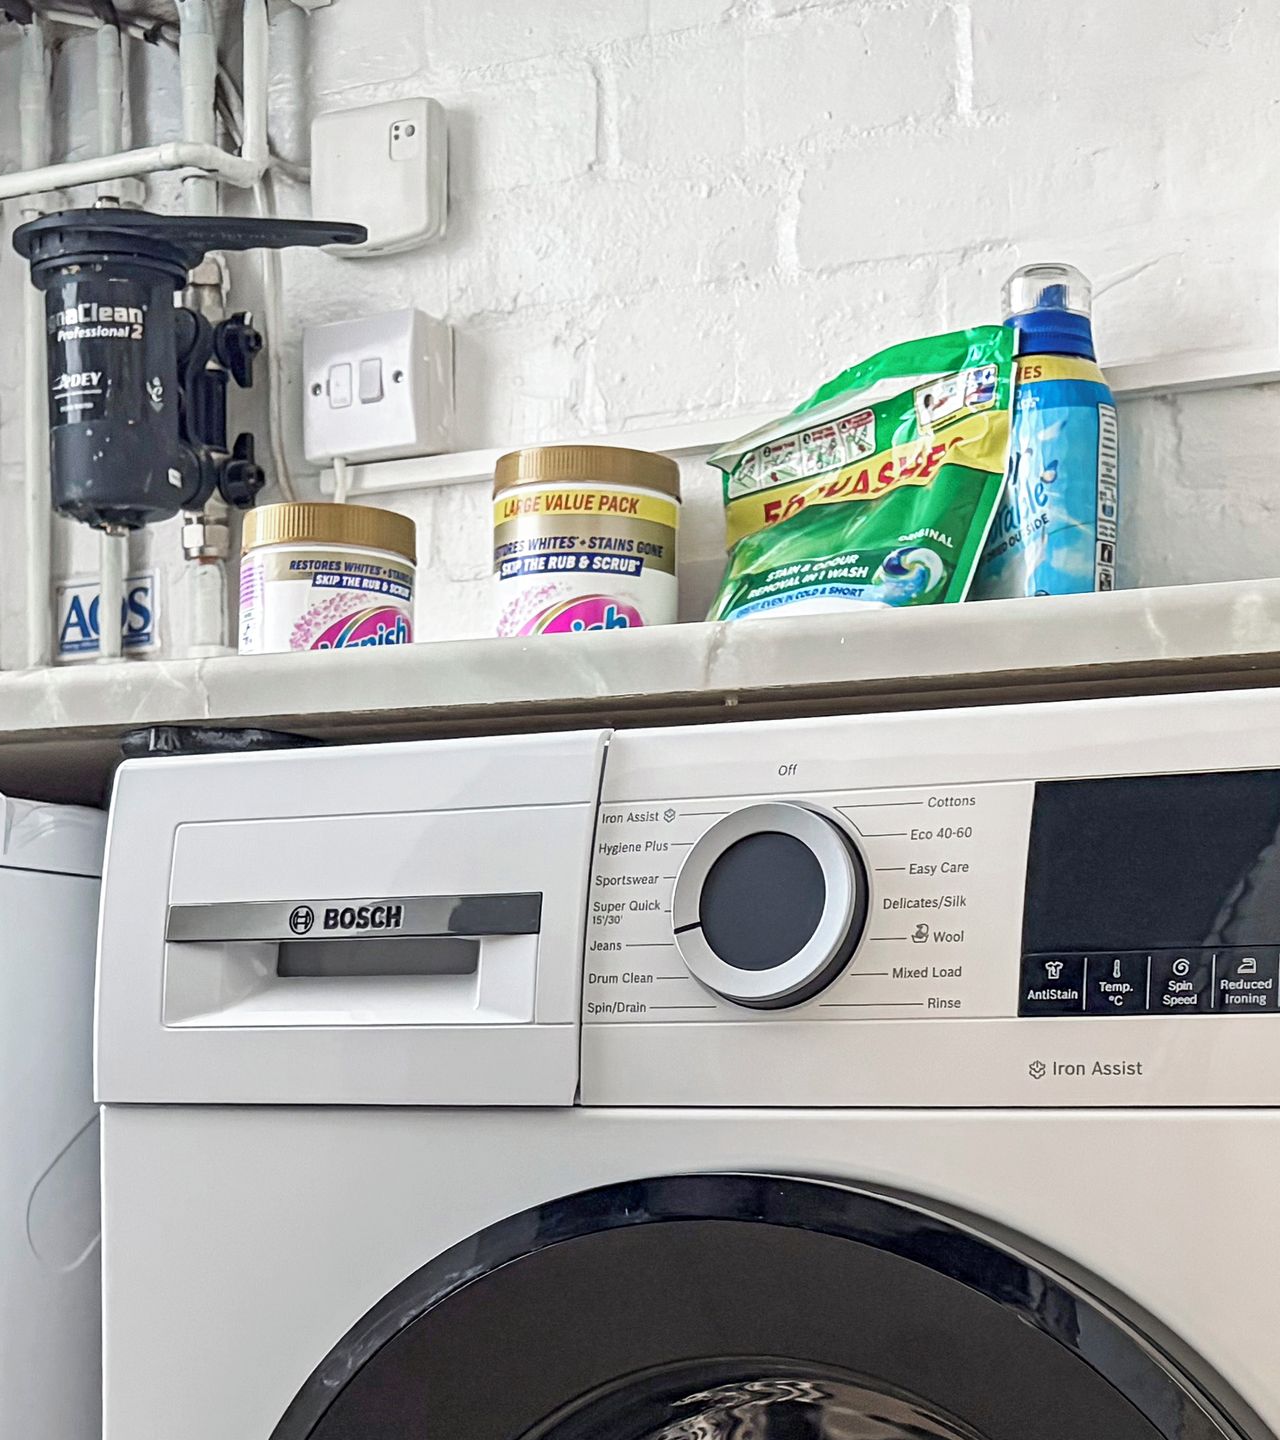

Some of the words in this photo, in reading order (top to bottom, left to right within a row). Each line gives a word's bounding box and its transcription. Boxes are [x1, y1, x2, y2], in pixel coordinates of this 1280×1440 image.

[57, 325, 131, 342] Professional
[131, 324, 143, 340] 2
[504, 496, 540, 518] LARGE
[545, 494, 595, 513] VALUE
[599, 496, 640, 514] PACK
[1009, 513, 1050, 547] OUSIDE
[588, 536, 634, 551] STAINS
[637, 541, 664, 558] GONE
[289, 560, 341, 571] RESTORES
[523, 558, 546, 572] THE
[548, 556, 576, 569] RUB
[579, 556, 590, 568] &
[766, 565, 802, 582] STAIN
[813, 554, 860, 572] ODOUR
[315, 574, 339, 586] SKIP
[342, 576, 360, 587] THE
[363, 578, 380, 590] RUB
[747, 577, 801, 600] REMOVAL
[828, 566, 868, 579] WASH
[828, 586, 864, 597] SHORT
[778, 764, 798, 776] Off
[927, 795, 976, 808] Cottons
[602, 813, 624, 823] Iron
[627, 811, 659, 823] Assist
[910, 828, 932, 840] Eco
[934, 827, 973, 839] 40-60
[598, 841, 642, 856] Hygiene
[645, 840, 669, 852] Plus
[909, 863, 937, 876] Easy
[940, 861, 969, 873] Care
[595, 873, 659, 888] Sportswear
[593, 901, 626, 915] Super
[628, 899, 661, 912] Quick
[883, 896, 967, 910] Delicates/Silk
[323, 905, 403, 930] BOSCH
[933, 930, 964, 943] Wool
[589, 939, 622, 952] Jeans
[588, 972, 617, 984] Drum
[618, 971, 653, 984] Clean
[892, 967, 926, 979] Mixed
[930, 966, 962, 978] Load
[1099, 980, 1134, 996] Temp.
[1168, 978, 1194, 994] Spin
[1220, 976, 1272, 992] Reduced
[1027, 986, 1078, 1002] AntiStain
[1162, 992, 1198, 1008] Speed
[1224, 991, 1268, 1006] Ironing
[587, 1001, 647, 1015] Spin/Drain
[927, 997, 961, 1008] Rinse
[1052, 1060, 1086, 1076] Iron
[1091, 1060, 1143, 1076] Assist
